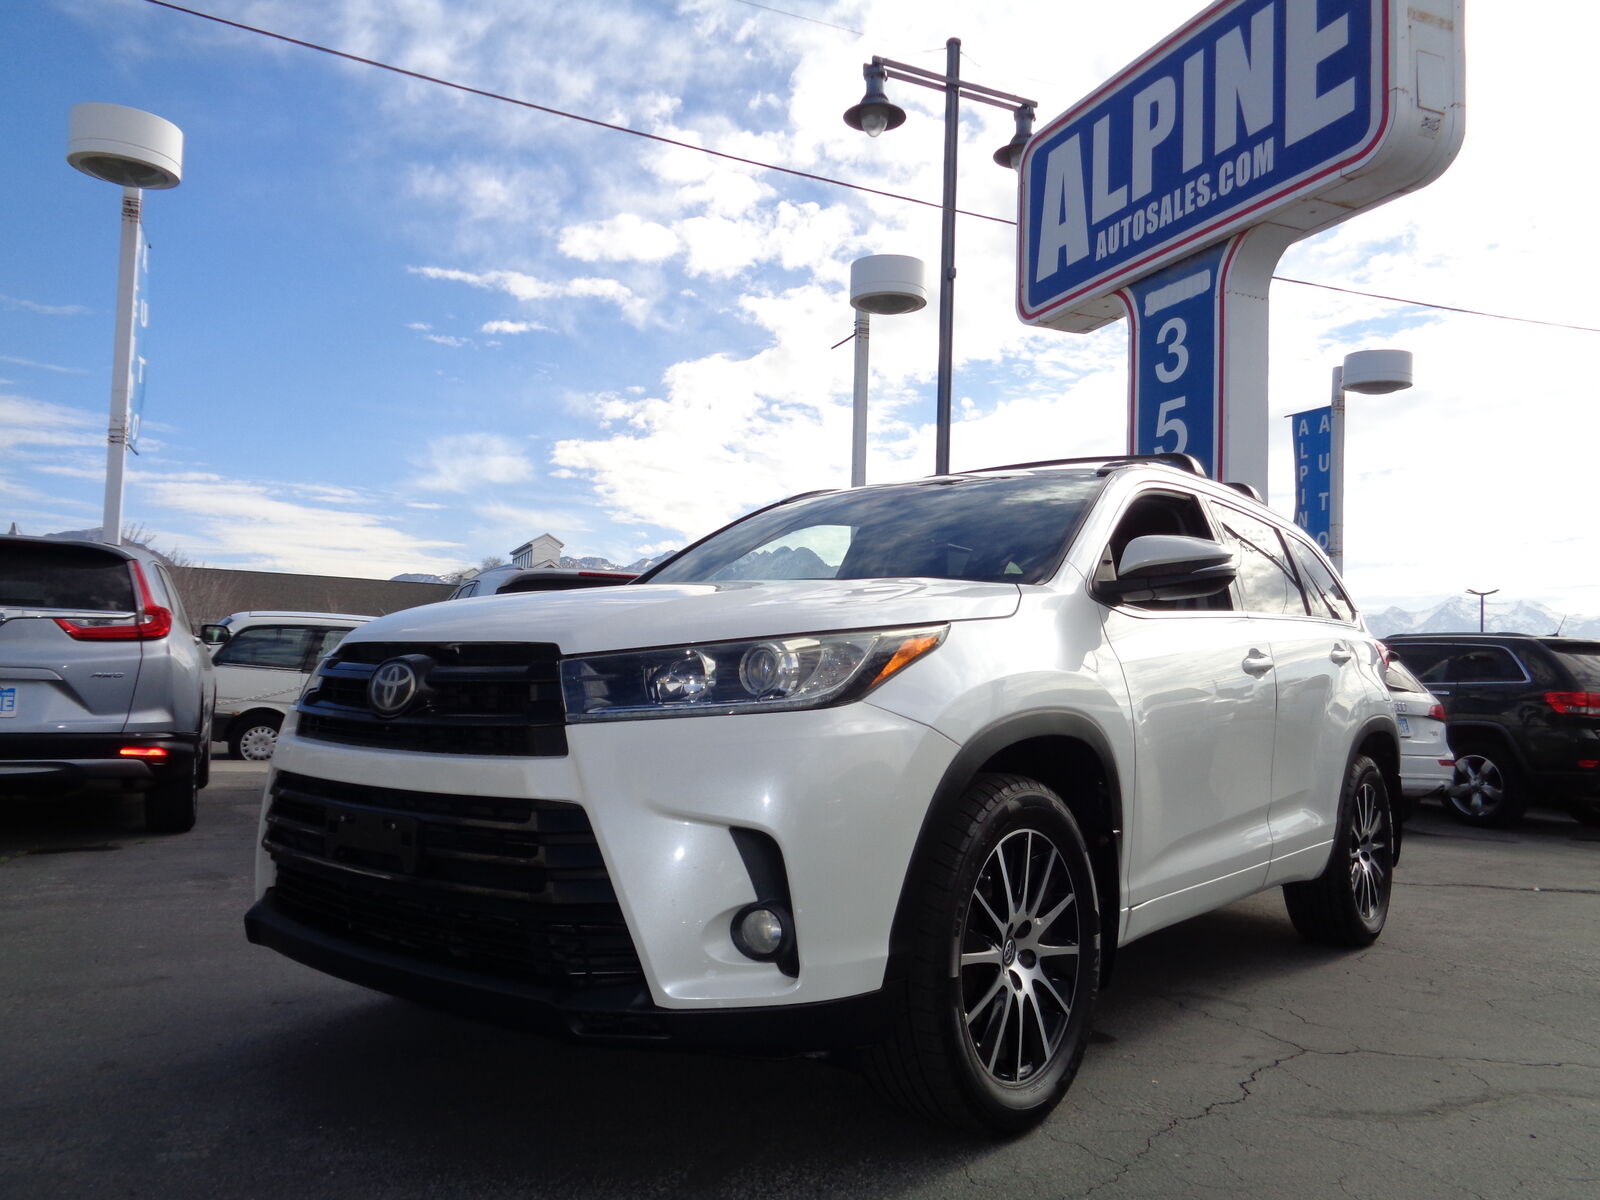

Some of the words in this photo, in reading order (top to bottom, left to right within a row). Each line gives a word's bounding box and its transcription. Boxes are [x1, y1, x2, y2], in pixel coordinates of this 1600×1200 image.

[1036, 0, 1356, 283] ALPINE
[1095, 137, 1274, 262] AUTOSALES.COM
[1298, 419, 1309, 528] ALPIN
[1316, 414, 1330, 550] AUTO
